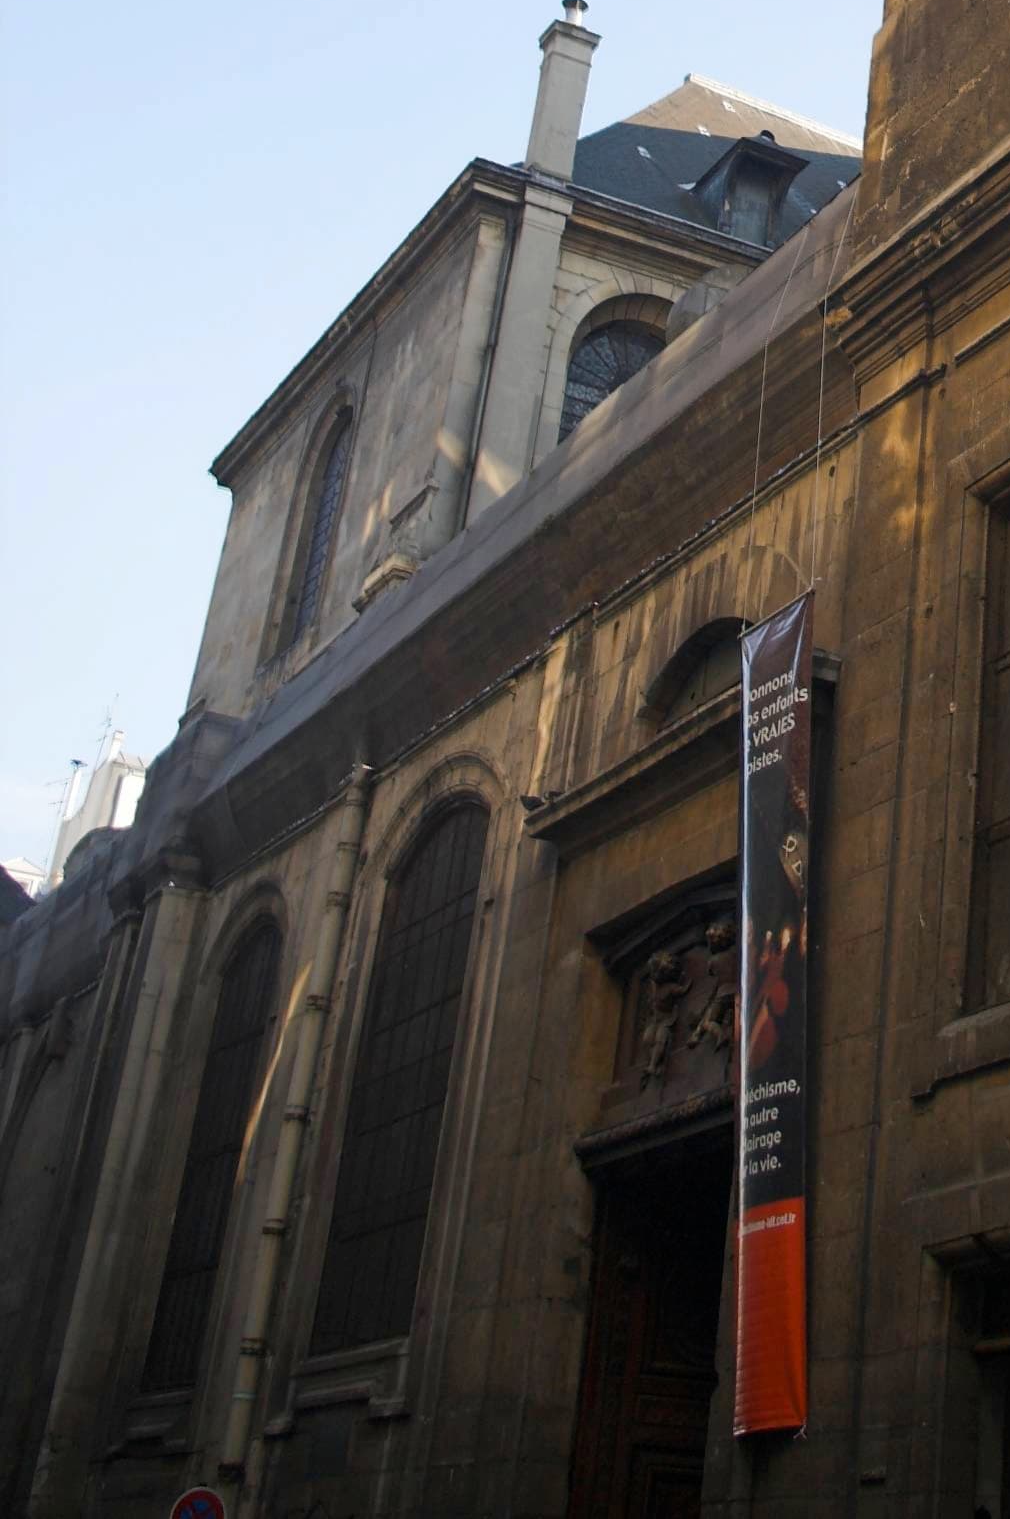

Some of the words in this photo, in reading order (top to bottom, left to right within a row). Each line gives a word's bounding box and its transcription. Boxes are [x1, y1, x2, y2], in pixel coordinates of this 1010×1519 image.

[749, 669, 794, 701] onnons
[761, 687, 809, 719] enfants
[752, 712, 796, 747] VRAIES
[749, 1106, 779, 1127] autre
[759, 1154, 782, 1172] vie.
